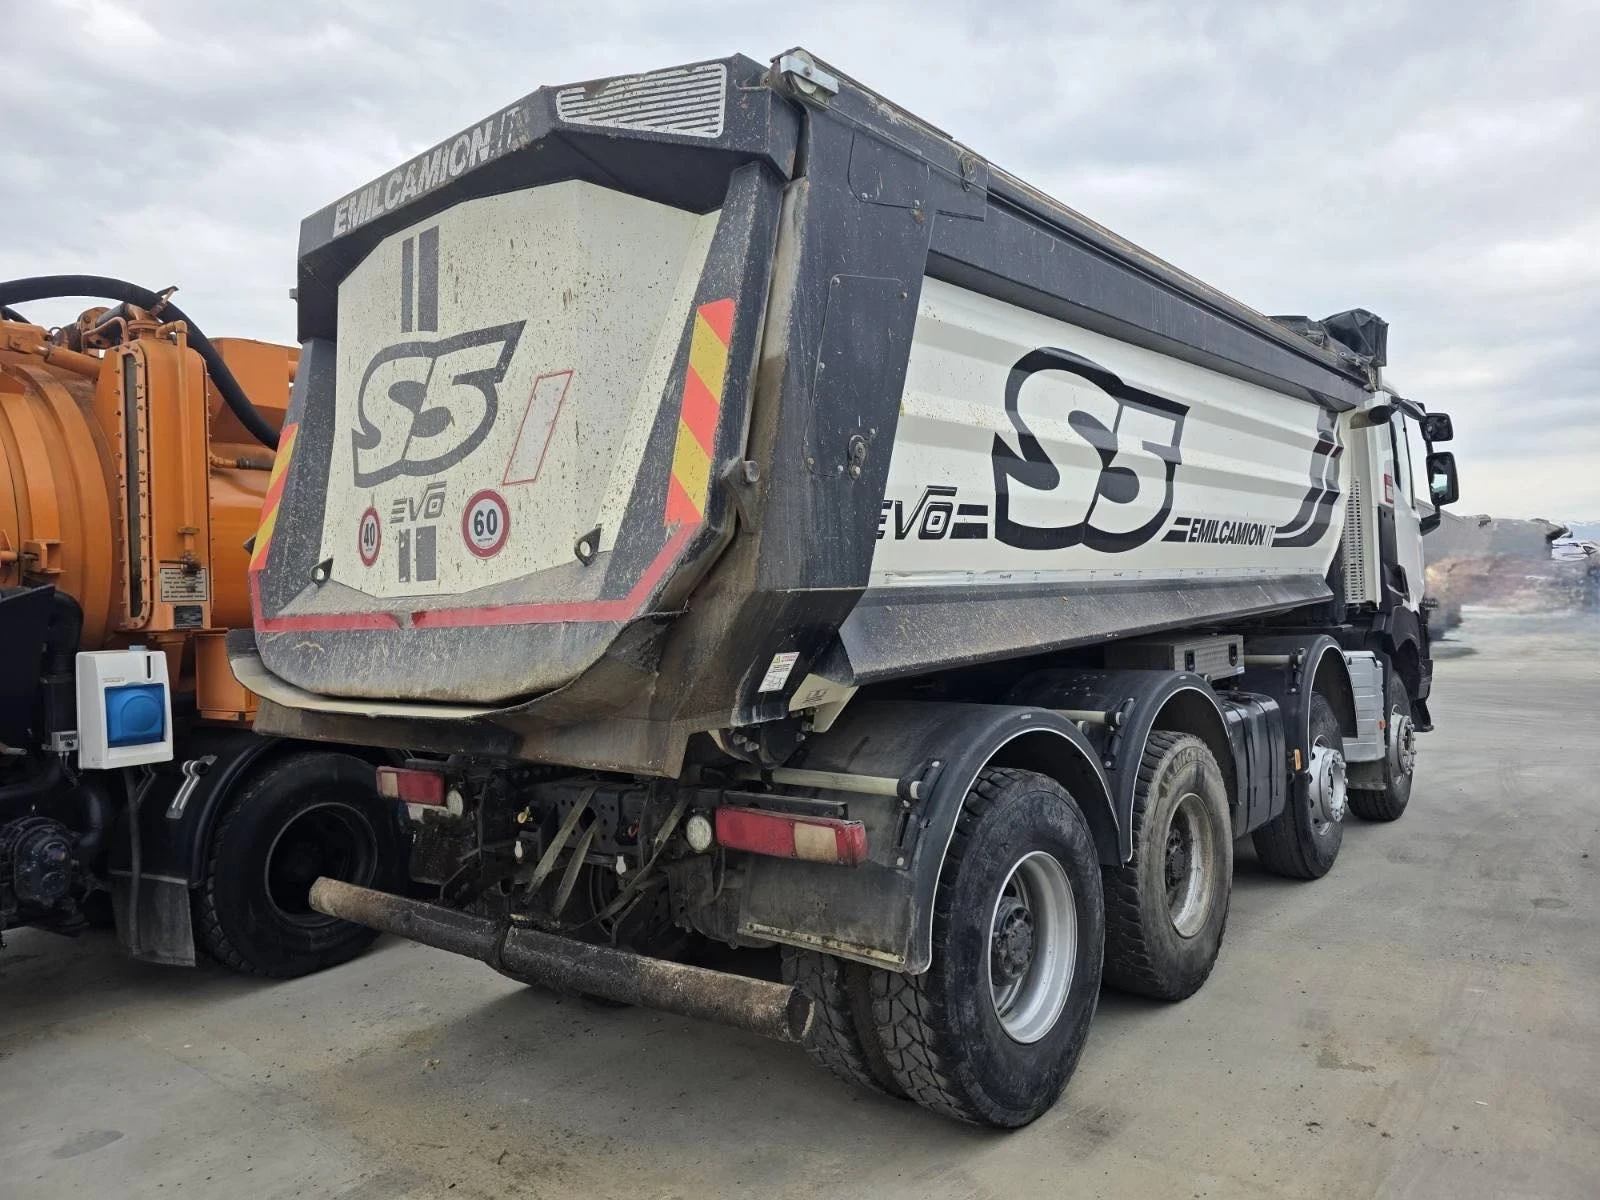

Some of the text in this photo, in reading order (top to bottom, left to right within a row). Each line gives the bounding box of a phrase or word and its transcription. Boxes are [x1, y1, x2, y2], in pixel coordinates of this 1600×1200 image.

[351, 320, 527, 488] S5
[991, 346, 1190, 553] S5
[390, 481, 447, 524] EVO
[364, 523, 375, 546] 40
[474, 509, 497, 536] 60
[1188, 518, 1275, 546] EMILCAMION.IT
